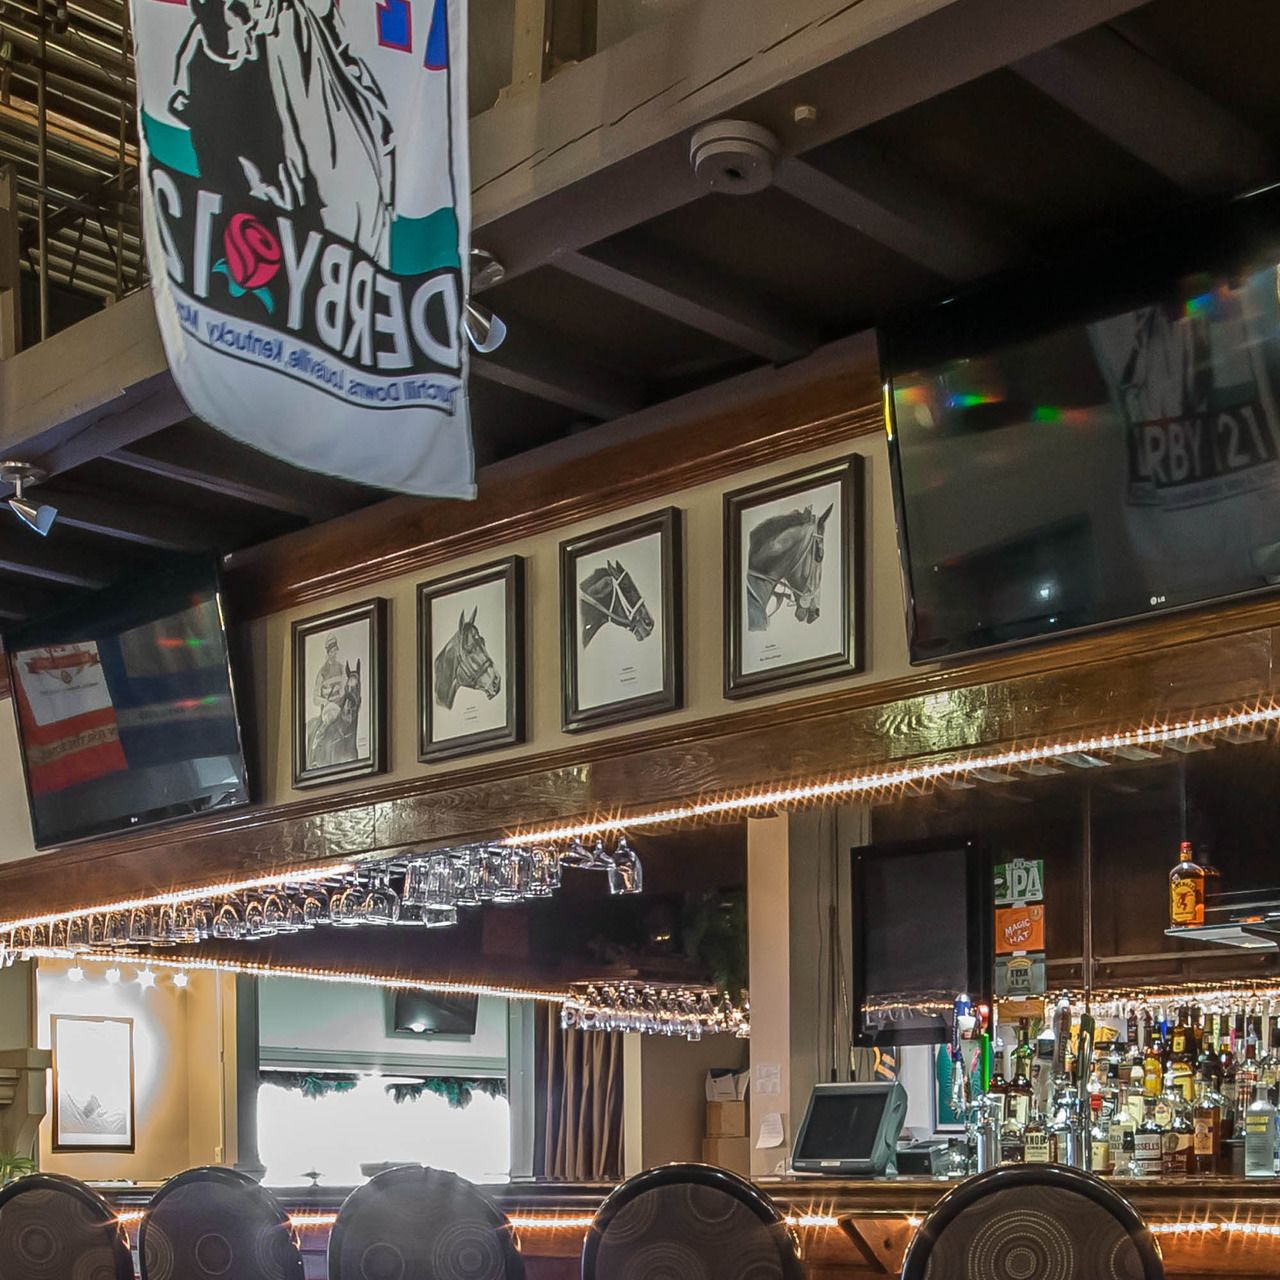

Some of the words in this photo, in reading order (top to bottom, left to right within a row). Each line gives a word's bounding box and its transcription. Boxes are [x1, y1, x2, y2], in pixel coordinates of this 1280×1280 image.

[1006, 867, 1042, 899] IPA
[1004, 918, 1031, 937] MAGIC
[1009, 930, 1030, 944] HAT
